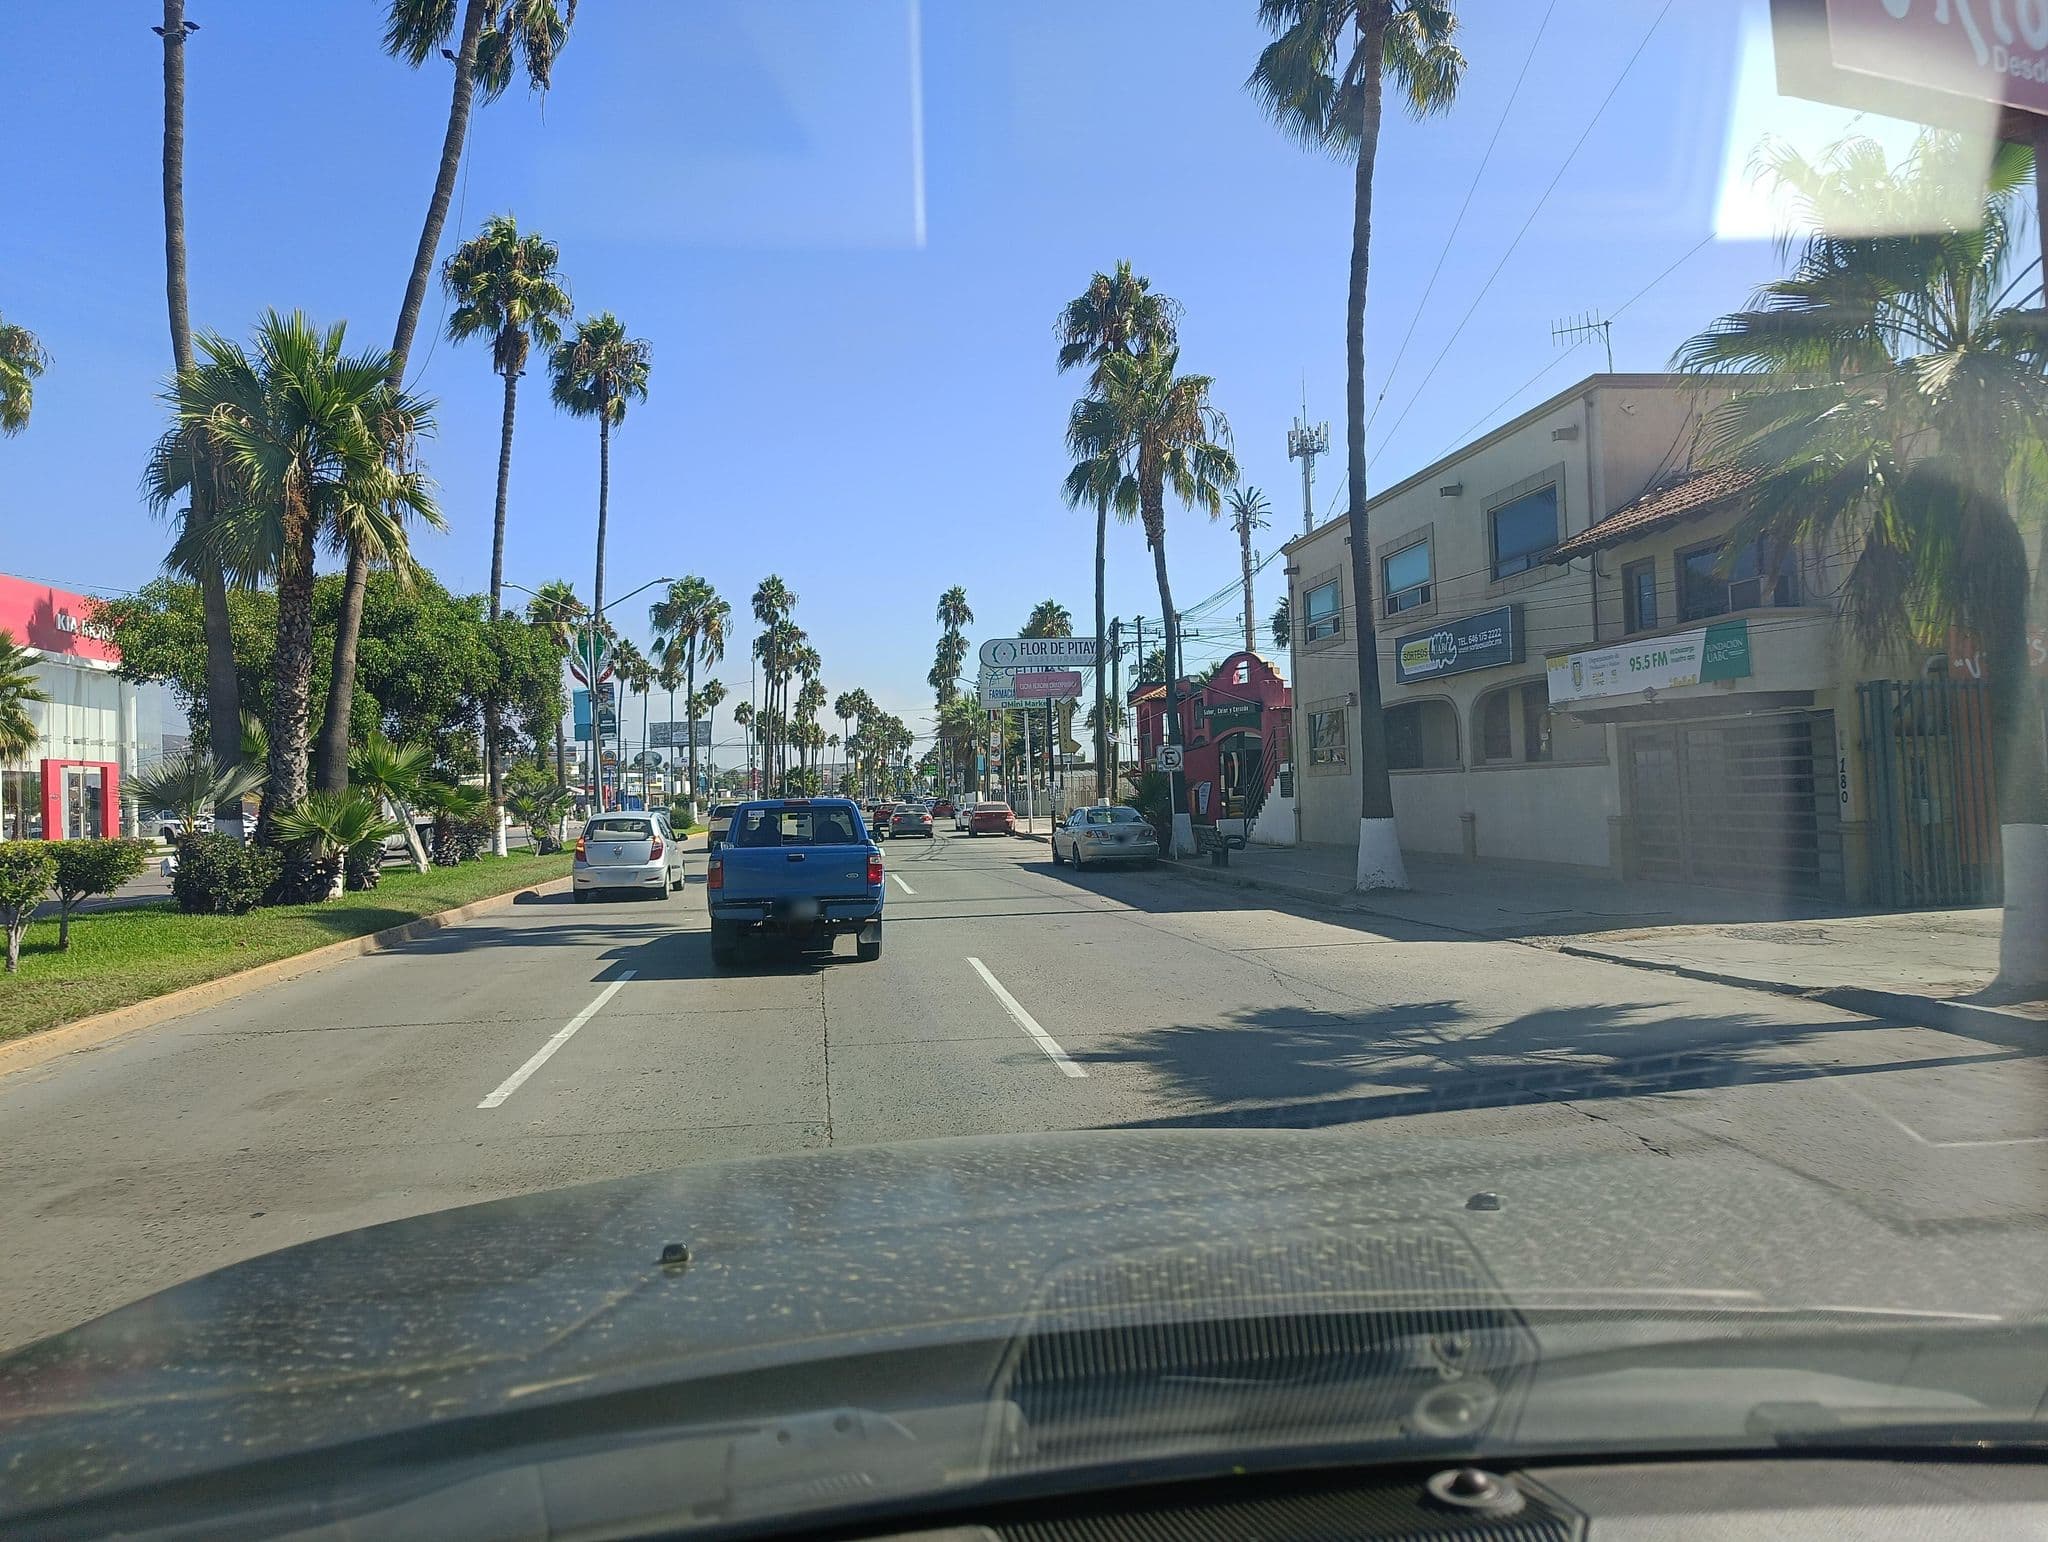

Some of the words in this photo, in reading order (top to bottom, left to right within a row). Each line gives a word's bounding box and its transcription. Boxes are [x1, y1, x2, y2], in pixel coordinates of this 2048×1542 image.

[1992, 45, 2048, 84] Desd
[56, 613, 77, 633] KIA
[1468, 633, 1478, 644] 646
[1478, 631, 1488, 642] 175
[1487, 628, 1502, 640] 2222
[1020, 642, 1047, 655] FLOR
[1050, 642, 1065, 655] DE
[1068, 641, 1097, 654] PITAY
[1403, 647, 1428, 662] SORTEOS
[1629, 654, 1650, 672] 95.5
[1653, 650, 1669, 668] FM
[1007, 701, 1023, 709] Mini
[1024, 700, 1048, 708] Marke
[1165, 751, 1175, 766] E
